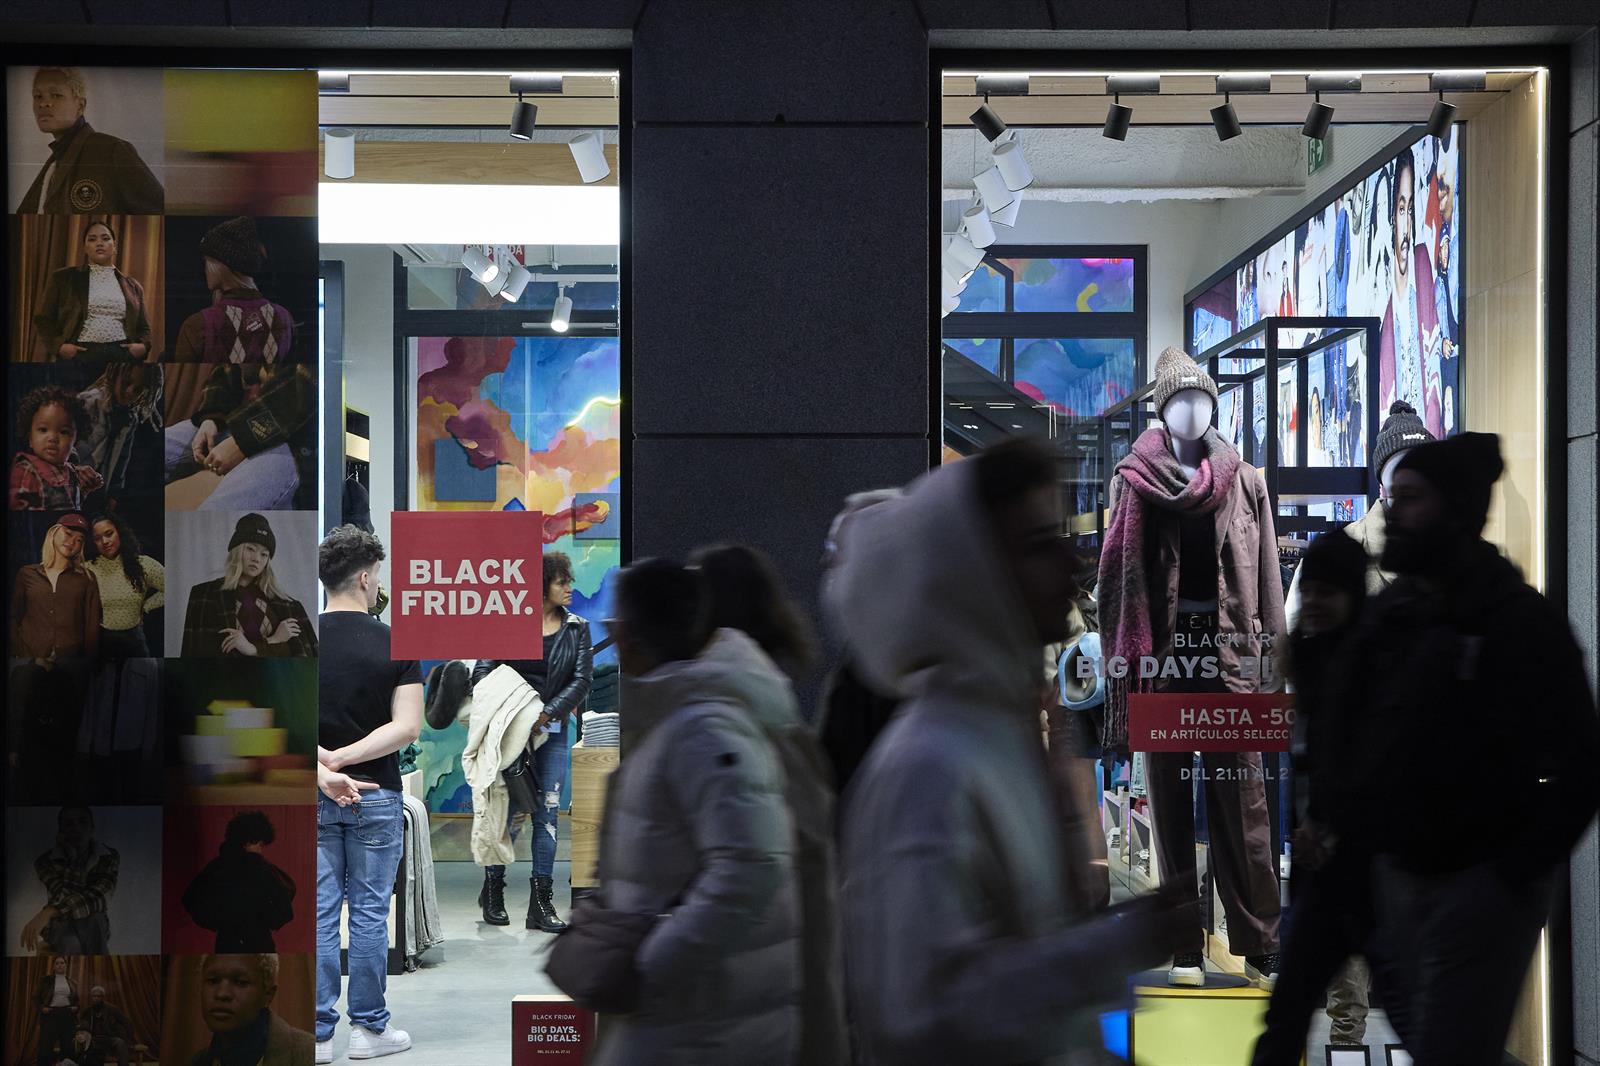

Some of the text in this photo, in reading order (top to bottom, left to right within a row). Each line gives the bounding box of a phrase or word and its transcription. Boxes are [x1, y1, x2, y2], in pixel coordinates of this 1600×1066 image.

[409, 559, 526, 585] BLACK
[401, 590, 533, 616] FRIDAY.
[1174, 633, 1278, 649] BLACK FR
[1076, 656, 1129, 679] BIG
[1140, 656, 1228, 679] DAYS.
[1180, 709, 1253, 725] HASTA
[1150, 730, 1167, 740] EN
[1171, 728, 1240, 740] ARTÍCULOS
[1180, 768, 1211, 781] DEL
[1215, 768, 1248, 781] 21.11
[1253, 768, 1275, 781] AL
[527, 1034, 544, 1042] BIG
